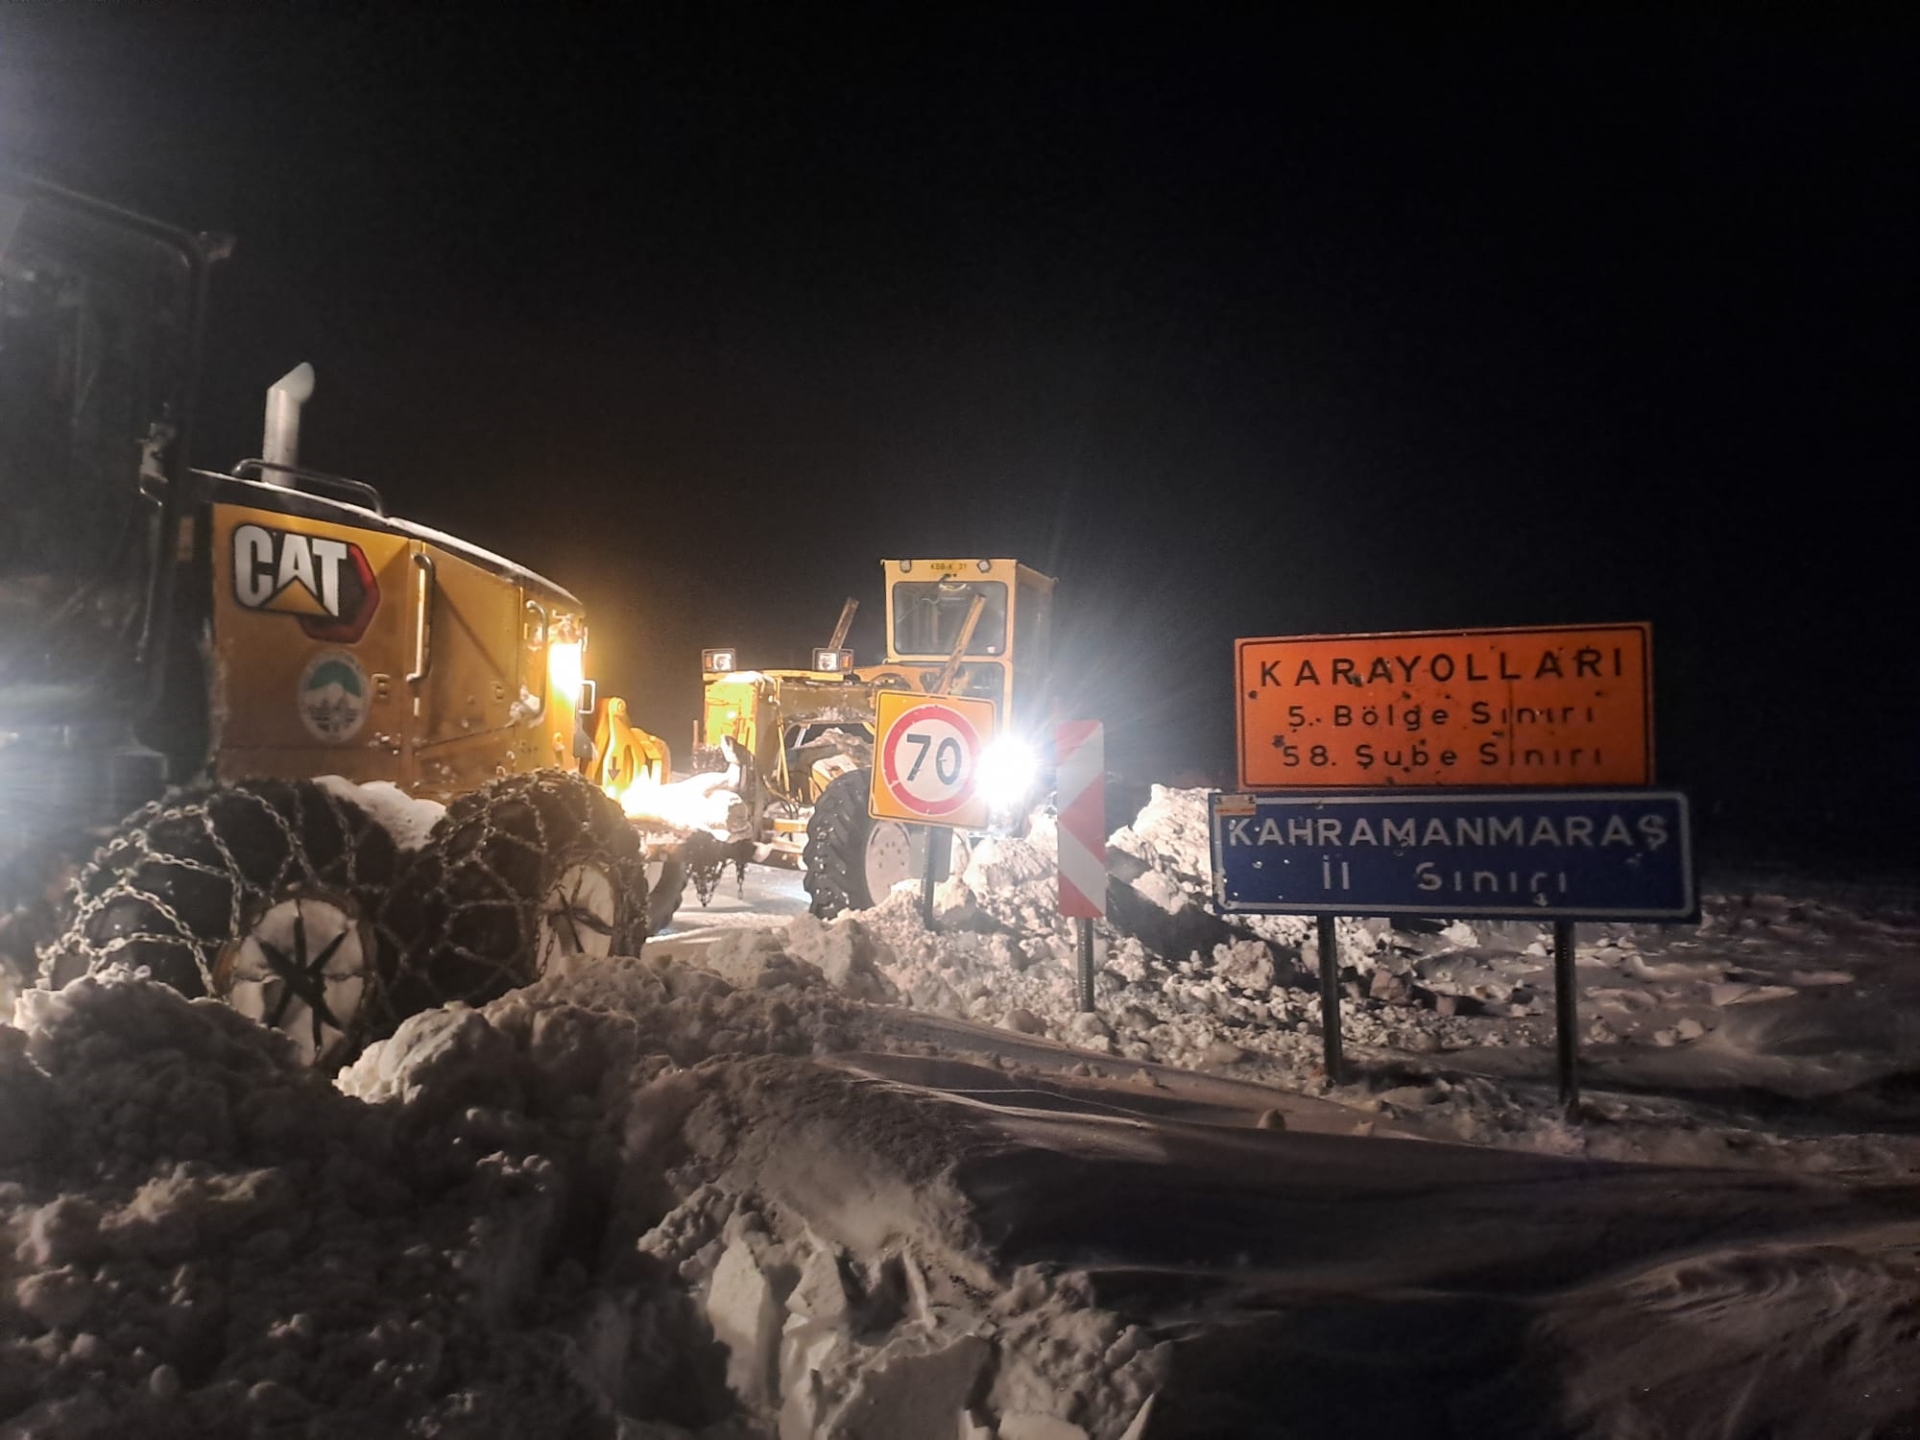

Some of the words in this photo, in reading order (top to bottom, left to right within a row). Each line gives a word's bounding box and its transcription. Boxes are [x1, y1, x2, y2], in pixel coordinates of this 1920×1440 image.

[234, 523, 347, 617] CAT
[1260, 647, 1623, 688] KARAYOLLARI
[1333, 703, 1450, 731] Bölge
[1472, 700, 1595, 725] Sınırı
[905, 733, 963, 786] 70
[1282, 744, 1337, 768] 58.
[1355, 743, 1458, 771] Şube
[1479, 742, 1602, 766] Sınırı
[1229, 813, 1669, 851] KAHRAMANMARAŞ
[1415, 861, 1567, 894] Sınırı
